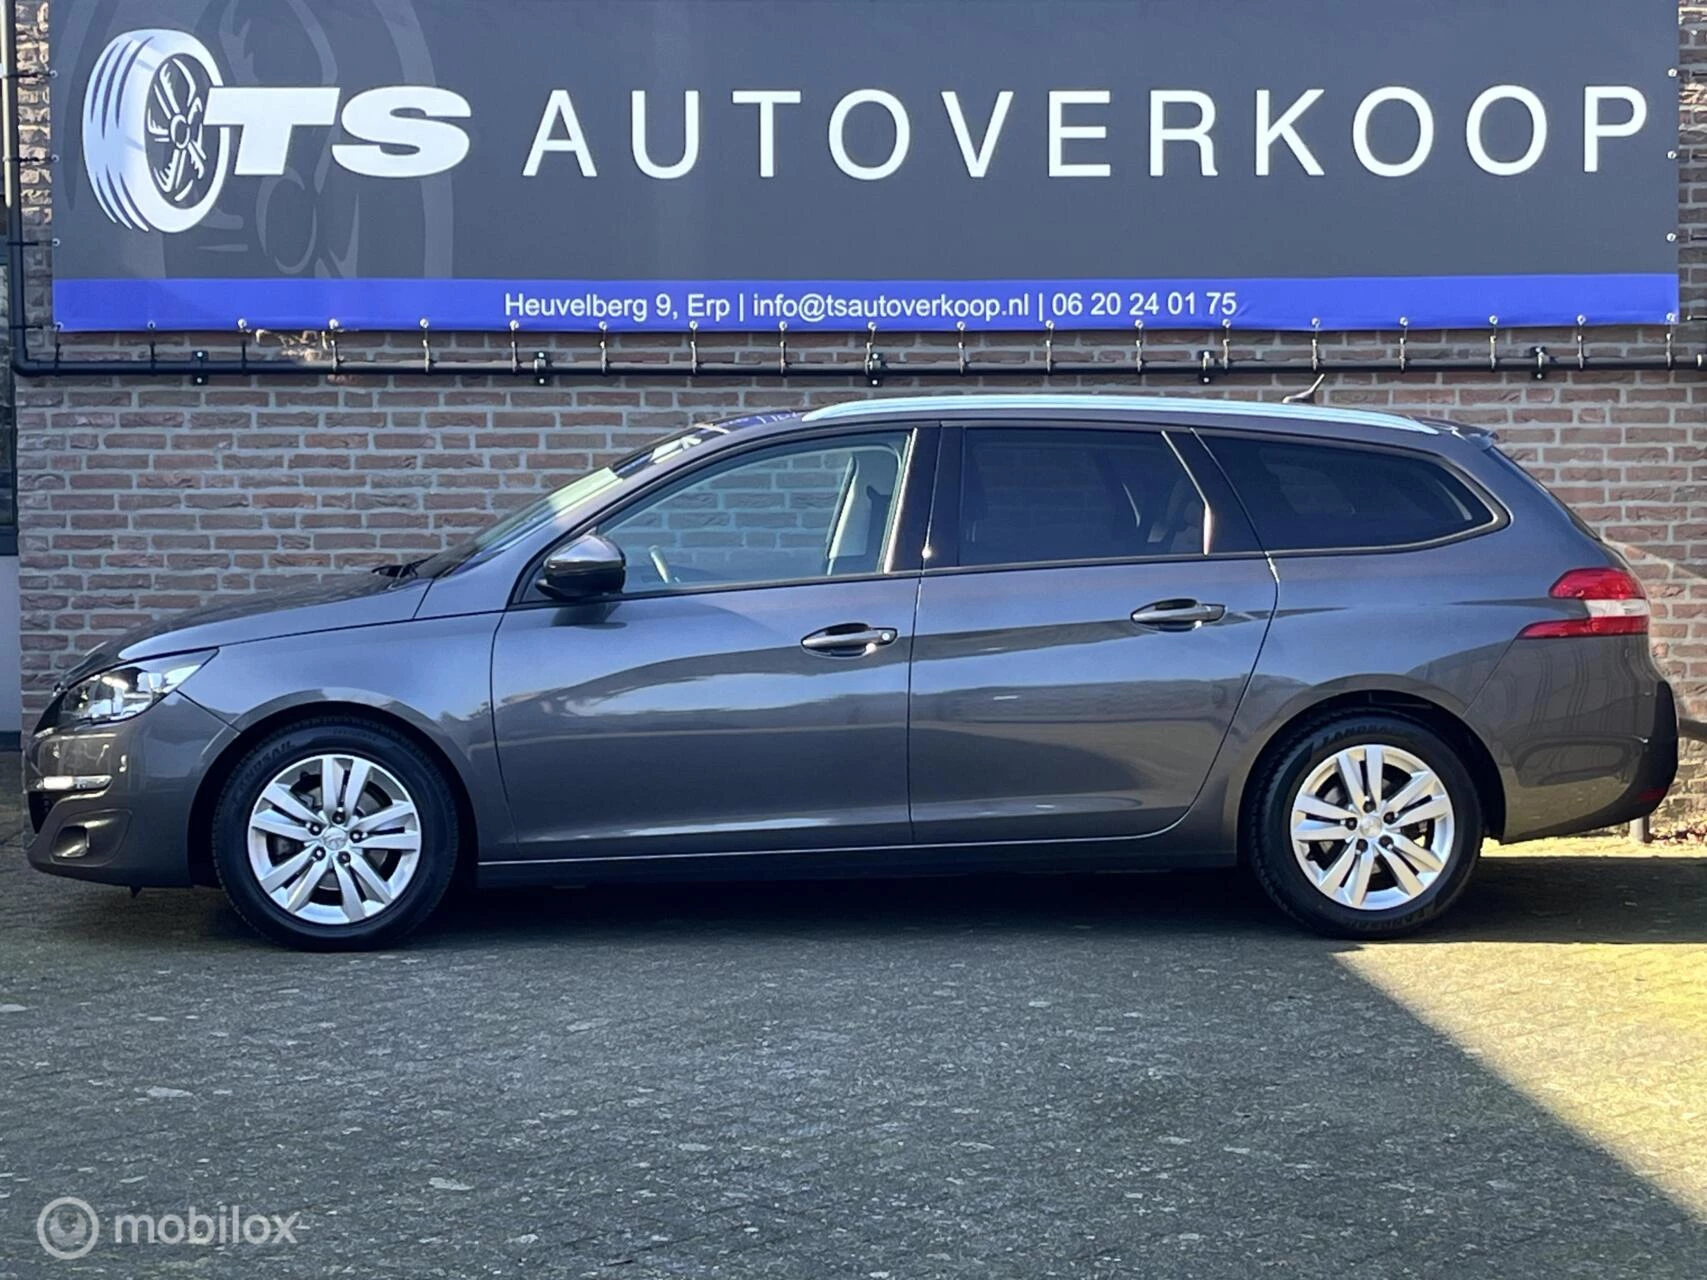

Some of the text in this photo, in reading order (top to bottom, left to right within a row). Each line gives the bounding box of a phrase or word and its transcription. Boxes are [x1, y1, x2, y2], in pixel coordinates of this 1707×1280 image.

[203, 85, 1648, 179] TS AUTOVERKOOP
[504, 293, 648, 322] Heuvelberg
[655, 293, 679, 320] 9,
[687, 293, 731, 322] Erp
[753, 293, 1030, 322] info@tsautoverkoop.nl
[1051, 292, 1083, 316] 06
[1090, 292, 1122, 316] 20
[1129, 292, 1160, 315] 24
[1167, 292, 1196, 315] 01
[1206, 292, 1237, 315] 75
